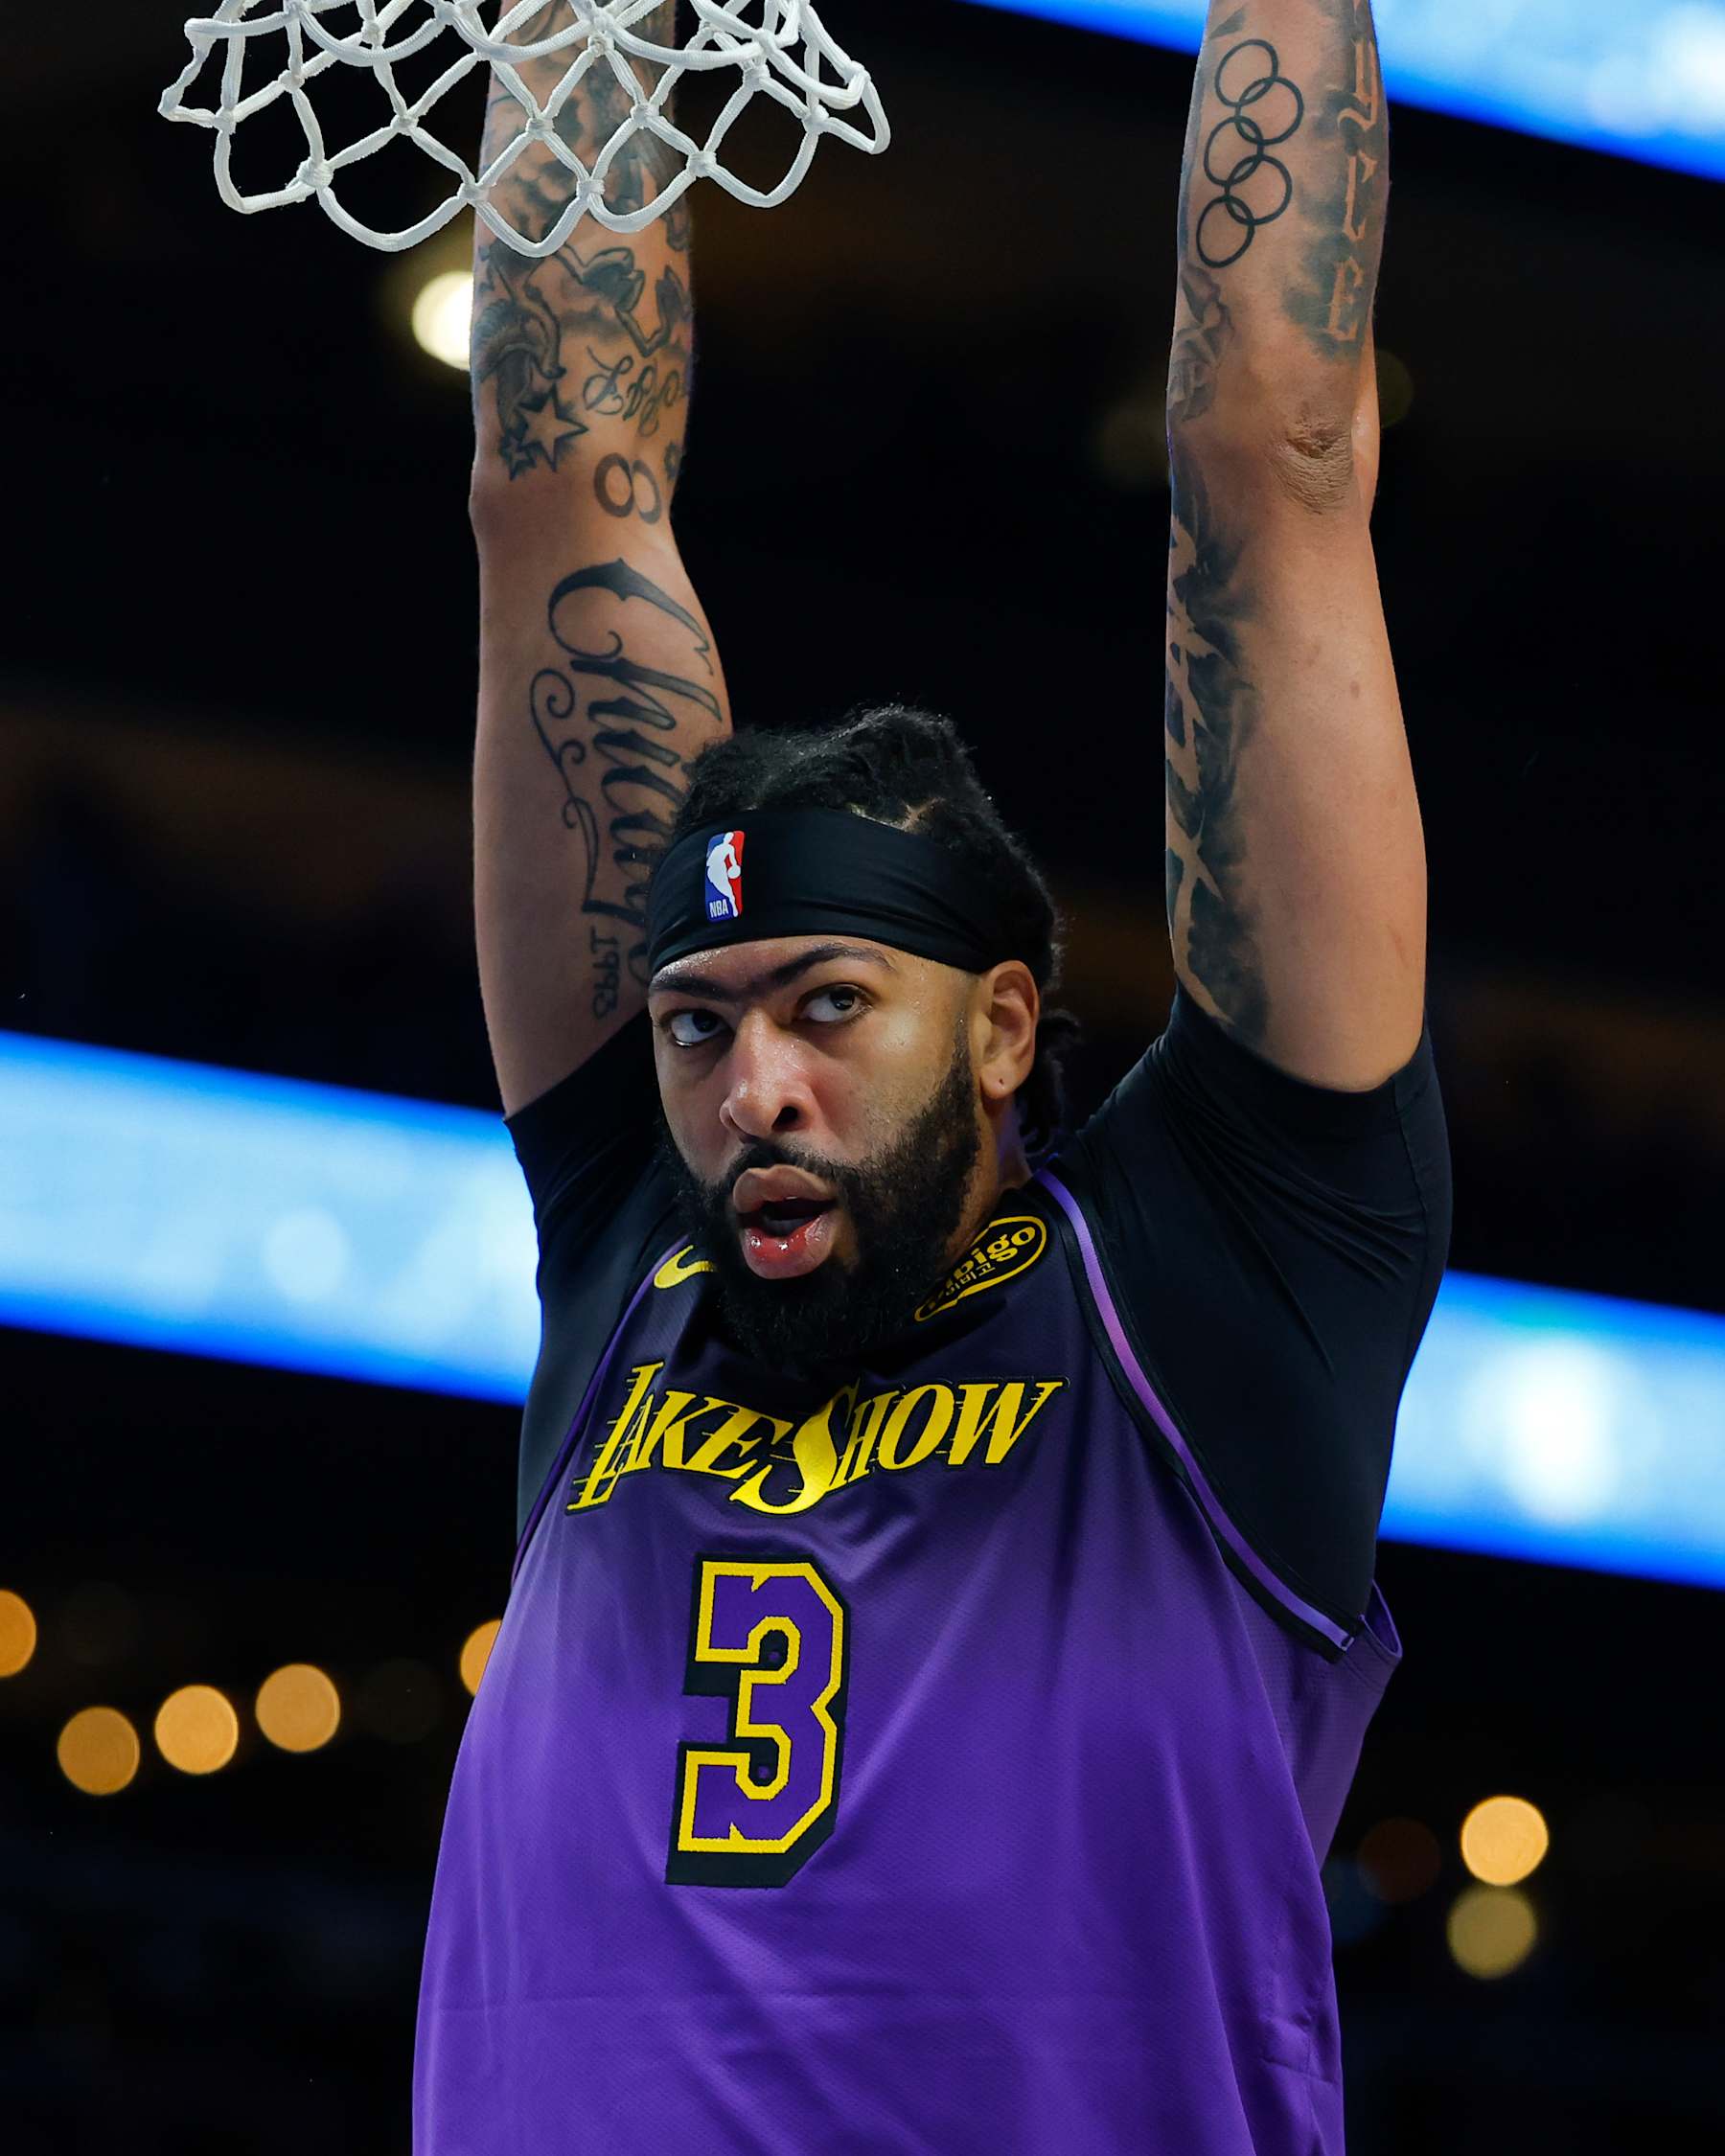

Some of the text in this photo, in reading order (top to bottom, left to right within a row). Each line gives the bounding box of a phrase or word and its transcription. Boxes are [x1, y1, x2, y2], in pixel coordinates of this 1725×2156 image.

[709, 898, 729, 918] NBA
[591, 927, 620, 1020] 1993
[671, 1557, 847, 1873] 3
